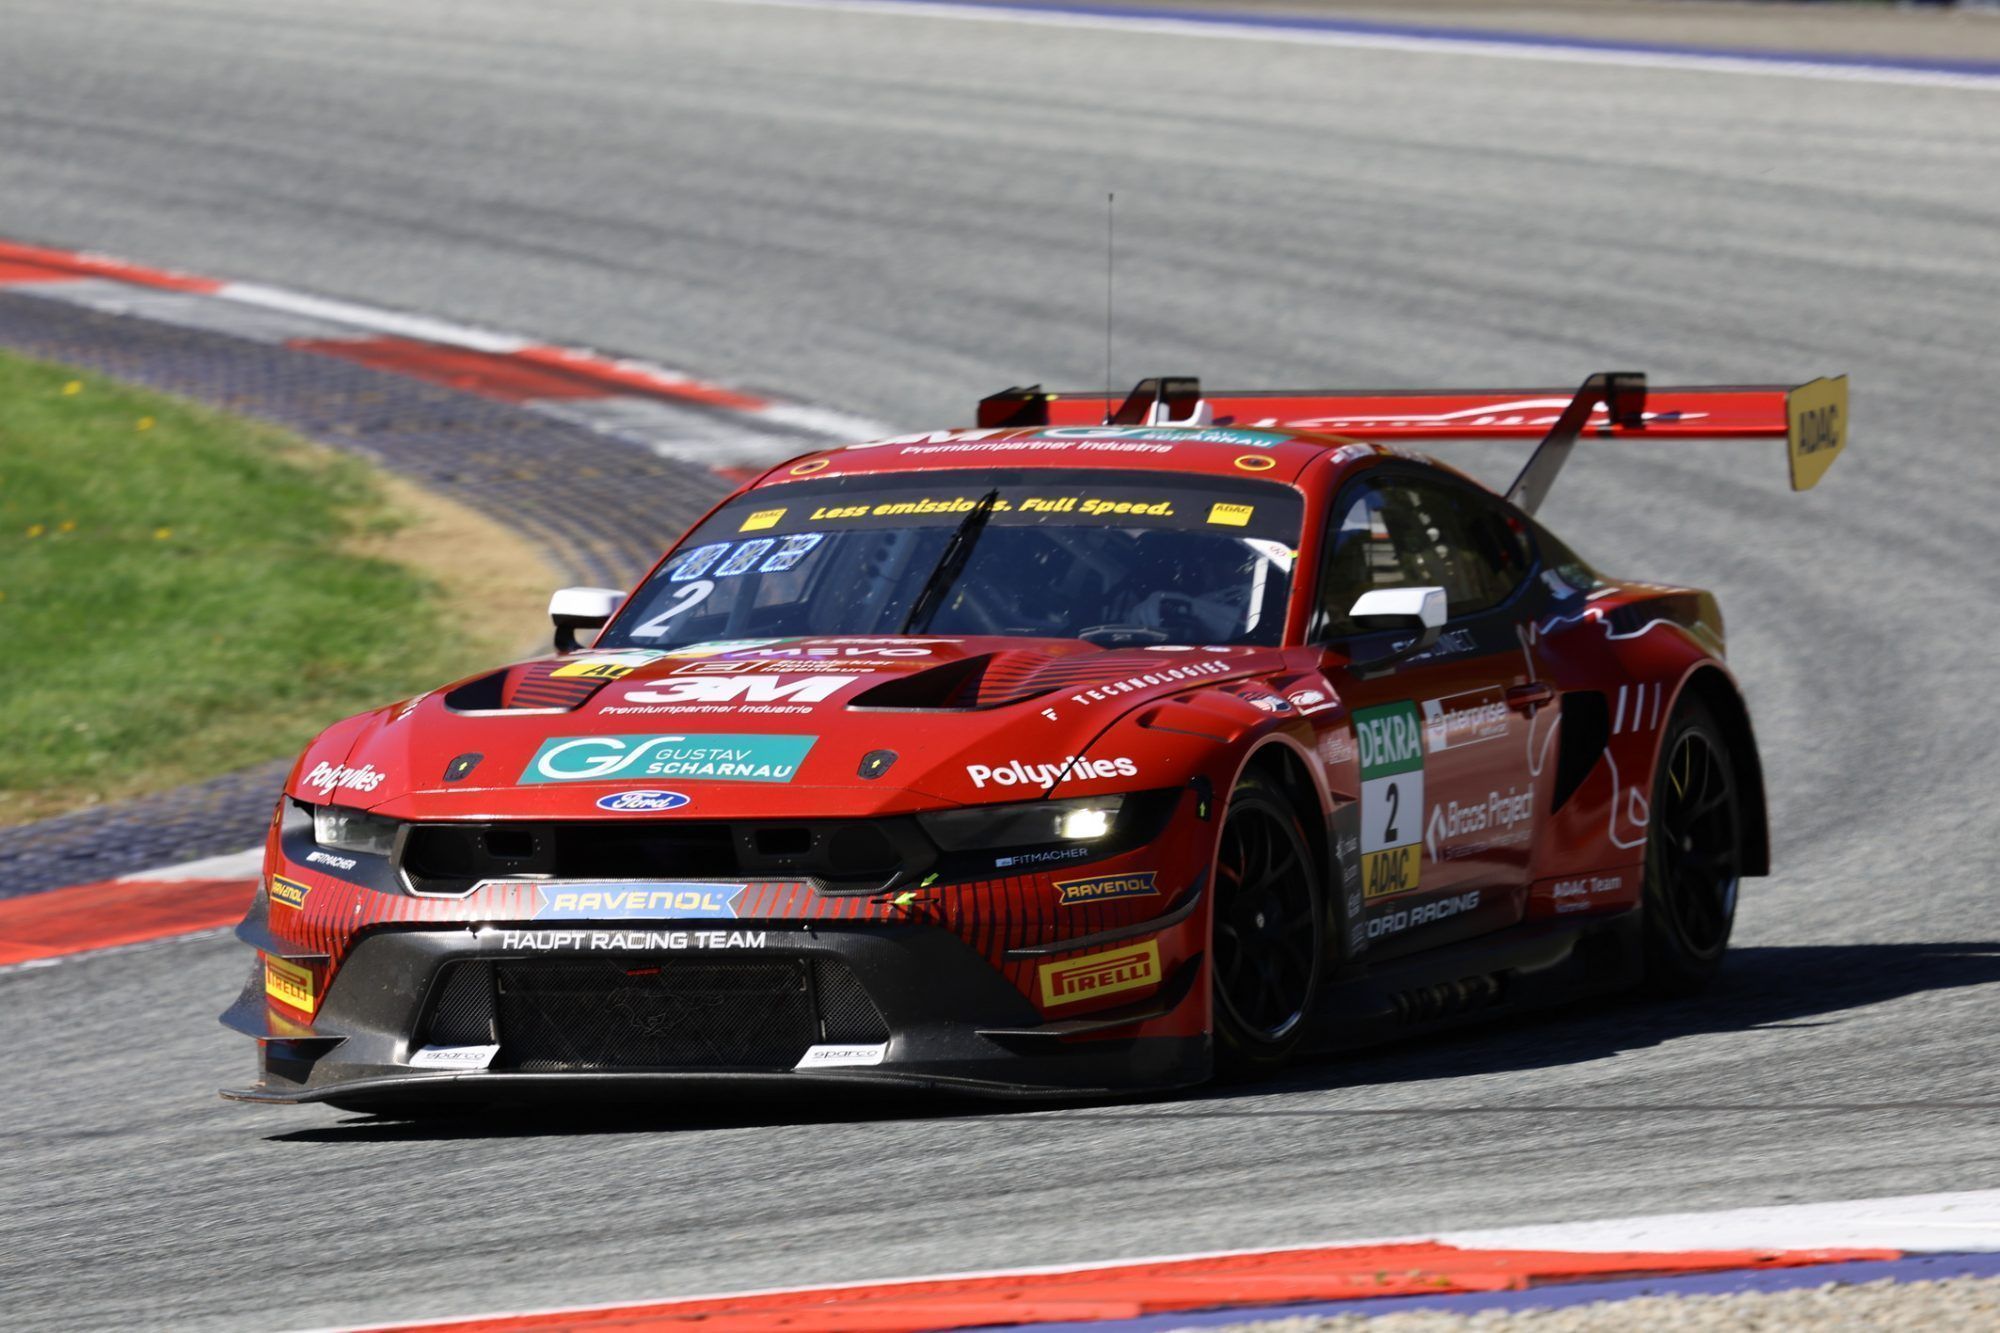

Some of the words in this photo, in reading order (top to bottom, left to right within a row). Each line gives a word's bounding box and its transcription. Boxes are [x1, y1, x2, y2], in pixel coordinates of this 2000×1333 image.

[1799, 404, 1838, 456] ADAC
[901, 440, 1074, 455] Premiumpartner
[1077, 440, 1173, 453] Industrie
[810, 503, 870, 520] Less
[873, 497, 1012, 516] emissios.
[1018, 497, 1078, 512] Full
[1078, 497, 1175, 516] Speed.
[629, 580, 715, 637] 2
[624, 674, 860, 703] 3M
[1071, 659, 1232, 705] TECHNOLOGIES
[599, 704, 736, 716] Premiumpartner
[738, 704, 814, 715] Industrie
[1356, 711, 1422, 768] DEKRA
[654, 748, 752, 761] GUSTAV
[303, 760, 386, 796] Polyvlies
[645, 761, 793, 778] SCHARNAU
[967, 754, 1139, 789] Polyvlies
[611, 792, 677, 809] Ford
[1383, 782, 1399, 843] 2
[1012, 847, 1089, 865] FITMACHER
[1367, 848, 1409, 896] ADAC
[1067, 876, 1151, 898] RAVENOL
[1365, 911, 1407, 939] ORD
[1409, 890, 1480, 926] RACING
[501, 932, 587, 951] HAUPT
[591, 931, 687, 950] RACING
[691, 931, 766, 949] TEAM
[1051, 950, 1152, 996] PIRELLI
[424, 1051, 486, 1062] sparco
[813, 1048, 879, 1061] sparco
